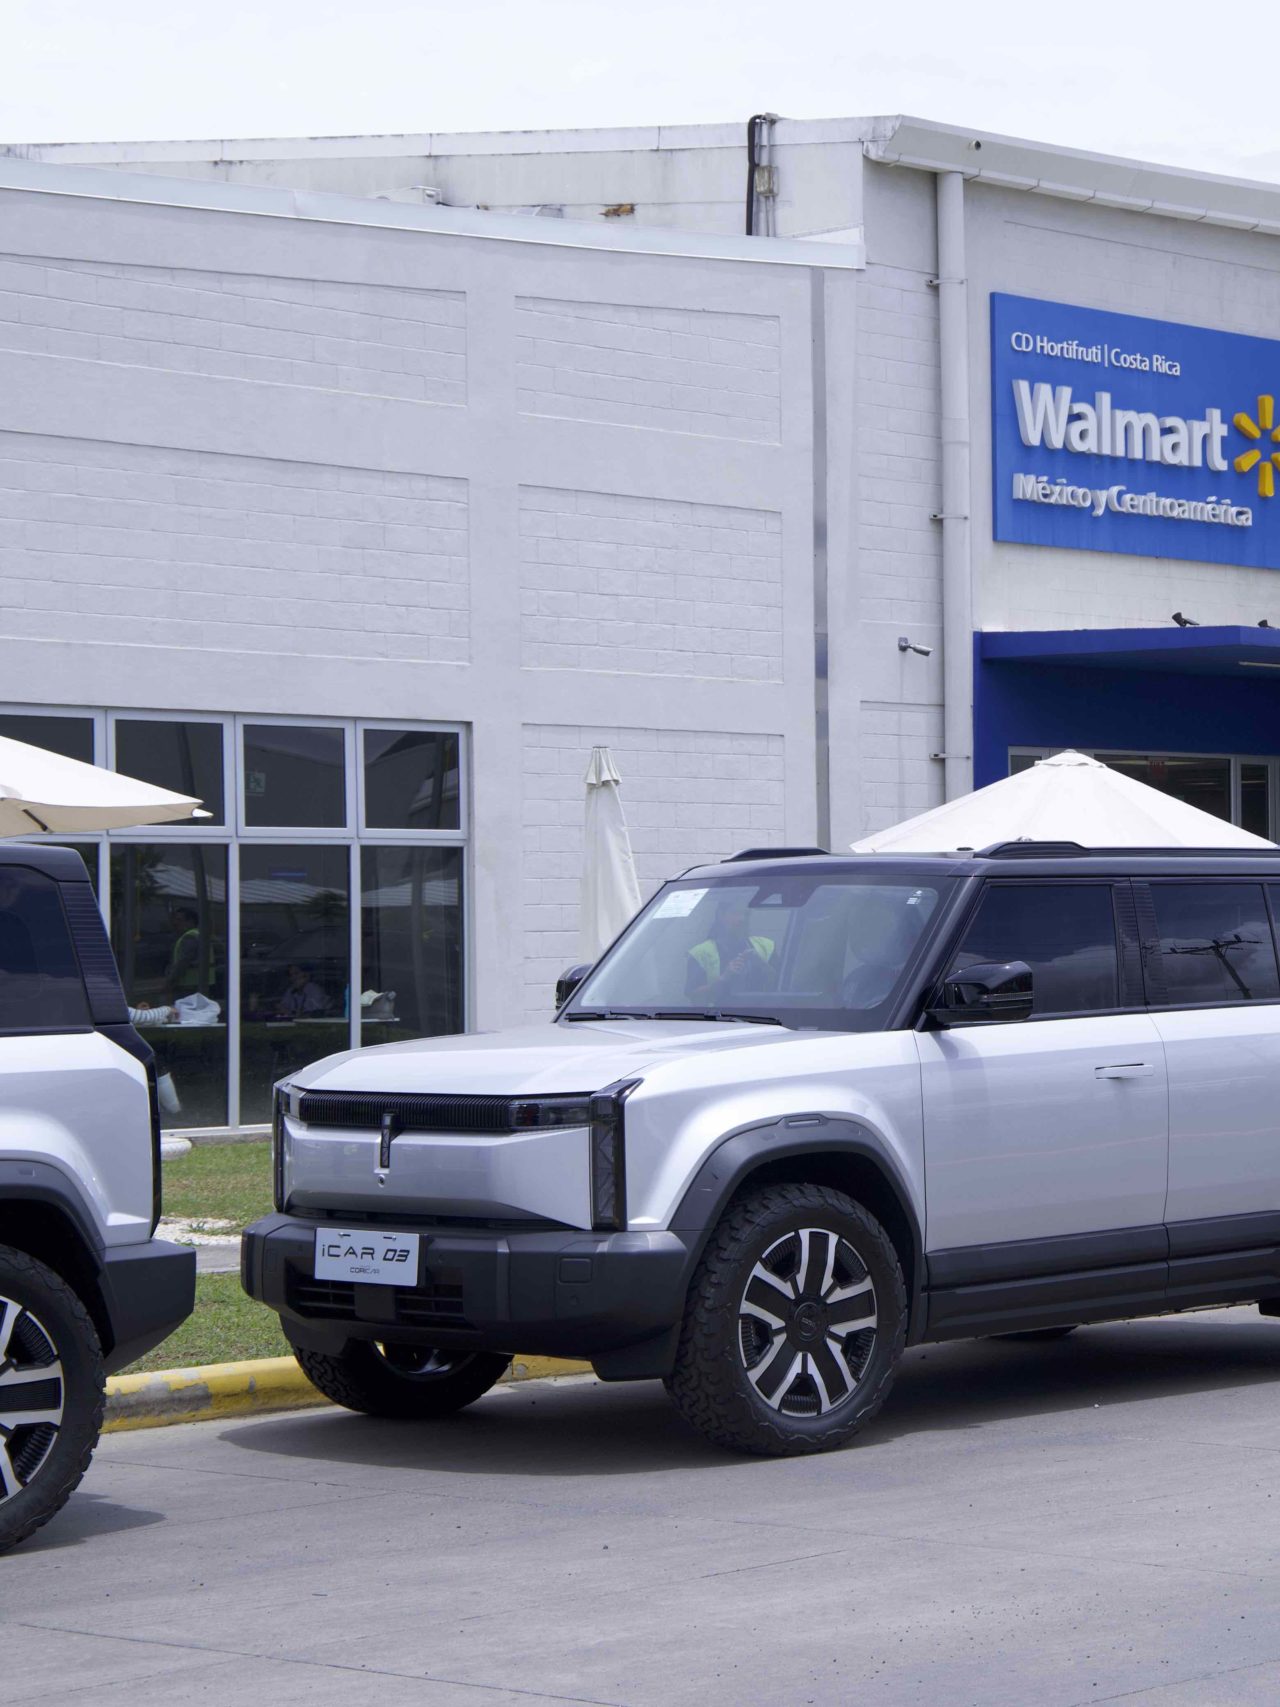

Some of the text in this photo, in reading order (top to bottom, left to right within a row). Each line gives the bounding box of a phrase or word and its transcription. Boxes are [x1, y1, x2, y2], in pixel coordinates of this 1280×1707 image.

[1011, 331, 1033, 352] CD
[1036, 335, 1101, 363] Hortifruti
[1111, 348, 1149, 371] Costa
[1152, 354, 1181, 376] Rica
[1012, 379, 1228, 472] Walmart
[1013, 473, 1253, 527] México y Centroamérica
[382, 1248, 410, 1262] 03
